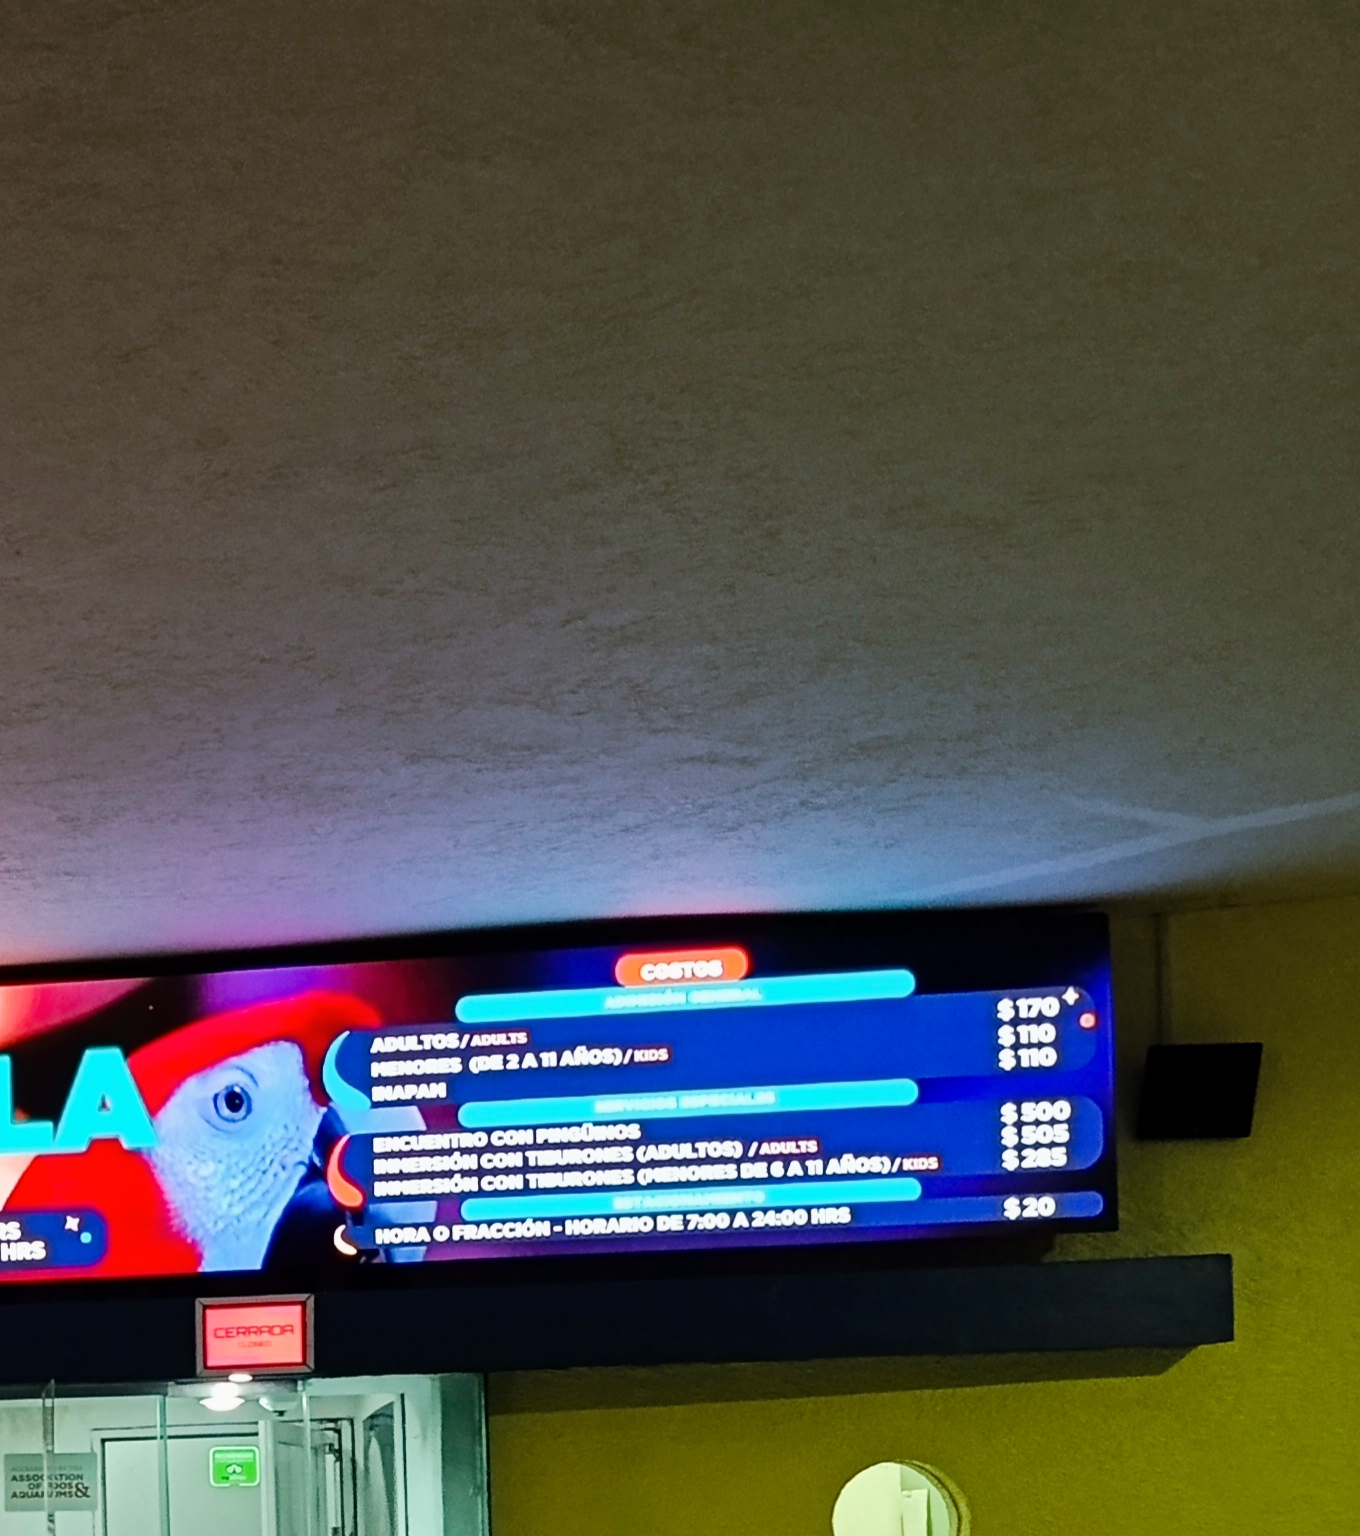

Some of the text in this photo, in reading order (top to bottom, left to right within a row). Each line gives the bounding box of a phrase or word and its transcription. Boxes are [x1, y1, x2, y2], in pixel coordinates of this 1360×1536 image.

[640, 959, 723, 981] COSTOS
[370, 1057, 463, 1078] MENORES
[468, 1054, 504, 1075] (DE
[505, 1053, 520, 1070] 2
[521, 1052, 538, 1069] A
[371, 1082, 447, 1102] INAPAM
[373, 1131, 488, 1153] ENCUENTRO
[490, 1129, 534, 1148] CON
[535, 1123, 641, 1145] PINGÜINOS
[373, 1152, 478, 1175] INMERSIÓN
[480, 1151, 524, 1170] CON
[525, 1145, 634, 1168] TIBURONES
[636, 1140, 743, 1163] (ADULTOS)
[374, 1174, 479, 1197] INMERSIÓN
[480, 1173, 524, 1192] CON
[525, 1168, 635, 1190] TIBURONES
[636, 1163, 739, 1186] (MENORES
[740, 1161, 769, 1180] DE
[770, 1161, 785, 1178] 6
[787, 1159, 804, 1177] A
[375, 1226, 431, 1245] HORA
[433, 1225, 450, 1242] O
[452, 1218, 551, 1241] FRACCIÓN
[565, 1214, 655, 1236] HORARIO
[656, 1213, 685, 1232] DE
[686, 1211, 731, 1231] 7:00
[732, 1211, 750, 1228] A
[751, 1209, 809, 1228] 24:00
[811, 1207, 852, 1225] HRS
[0, 1240, 47, 1262] HRS
[214, 1325, 294, 1338] CERRADA
